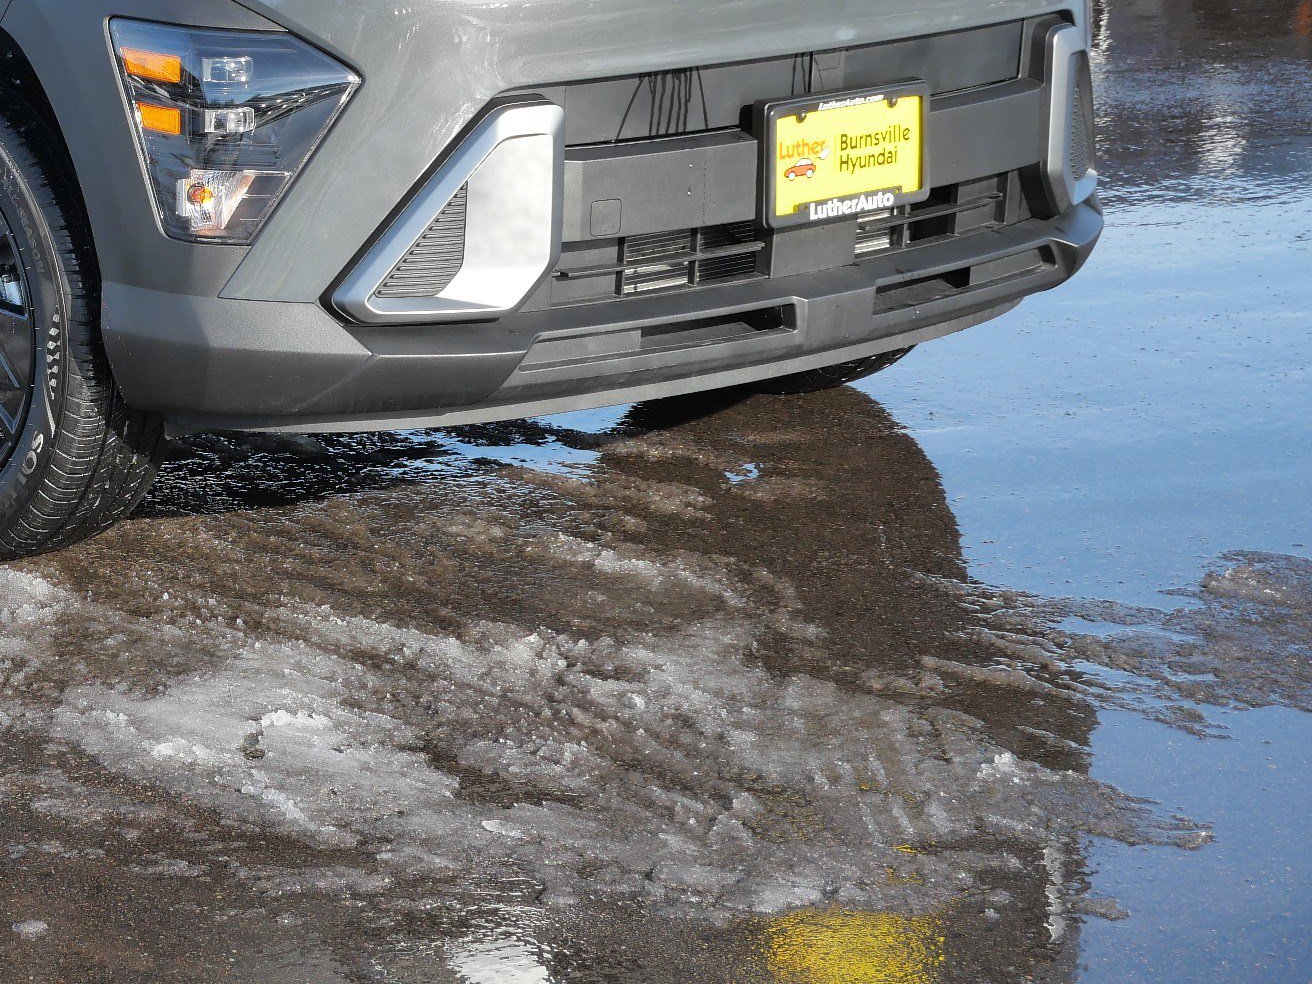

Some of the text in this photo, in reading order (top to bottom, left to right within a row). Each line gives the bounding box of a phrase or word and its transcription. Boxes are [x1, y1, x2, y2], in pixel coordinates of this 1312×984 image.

[779, 138, 826, 160] Luther
[839, 124, 911, 152] Burnsville
[839, 145, 899, 174] Hyundai
[809, 191, 895, 220] LutherAuto
